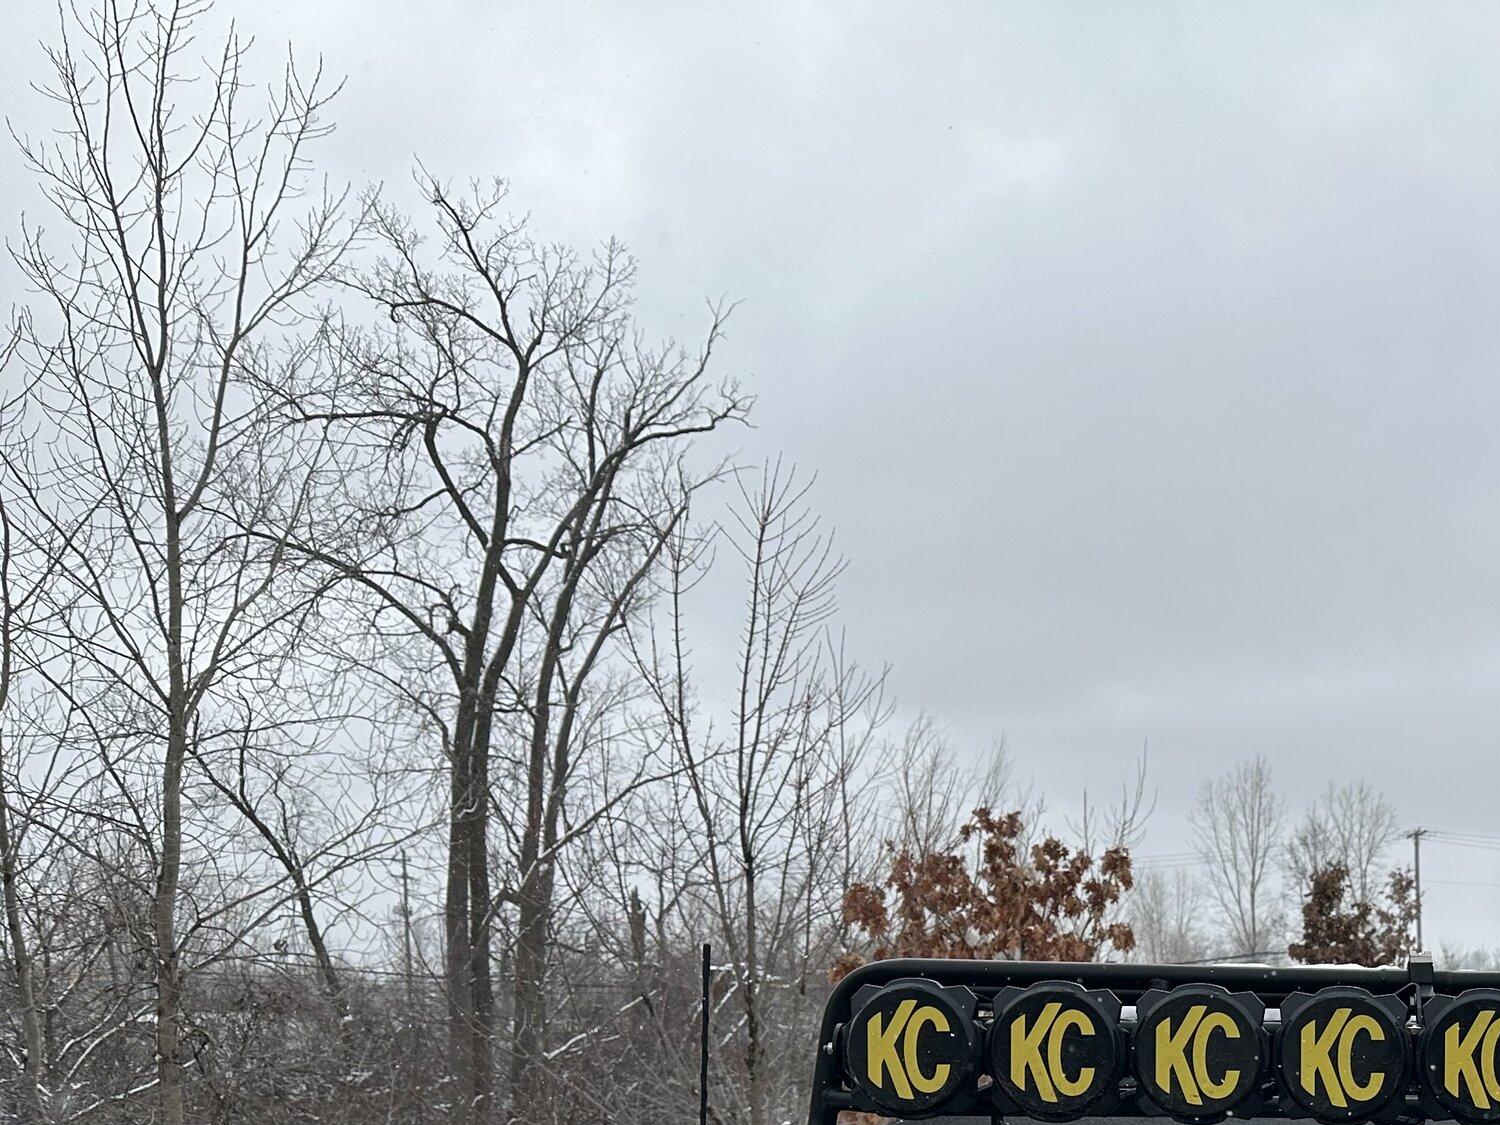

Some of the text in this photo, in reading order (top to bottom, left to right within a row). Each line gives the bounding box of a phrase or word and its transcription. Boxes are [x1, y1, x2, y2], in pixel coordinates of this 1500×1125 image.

[867, 999, 950, 1100] KC
[1010, 1002, 1095, 1103] KC
[1155, 1005, 1240, 1106] KC
[1300, 1007, 1385, 1108] KC
